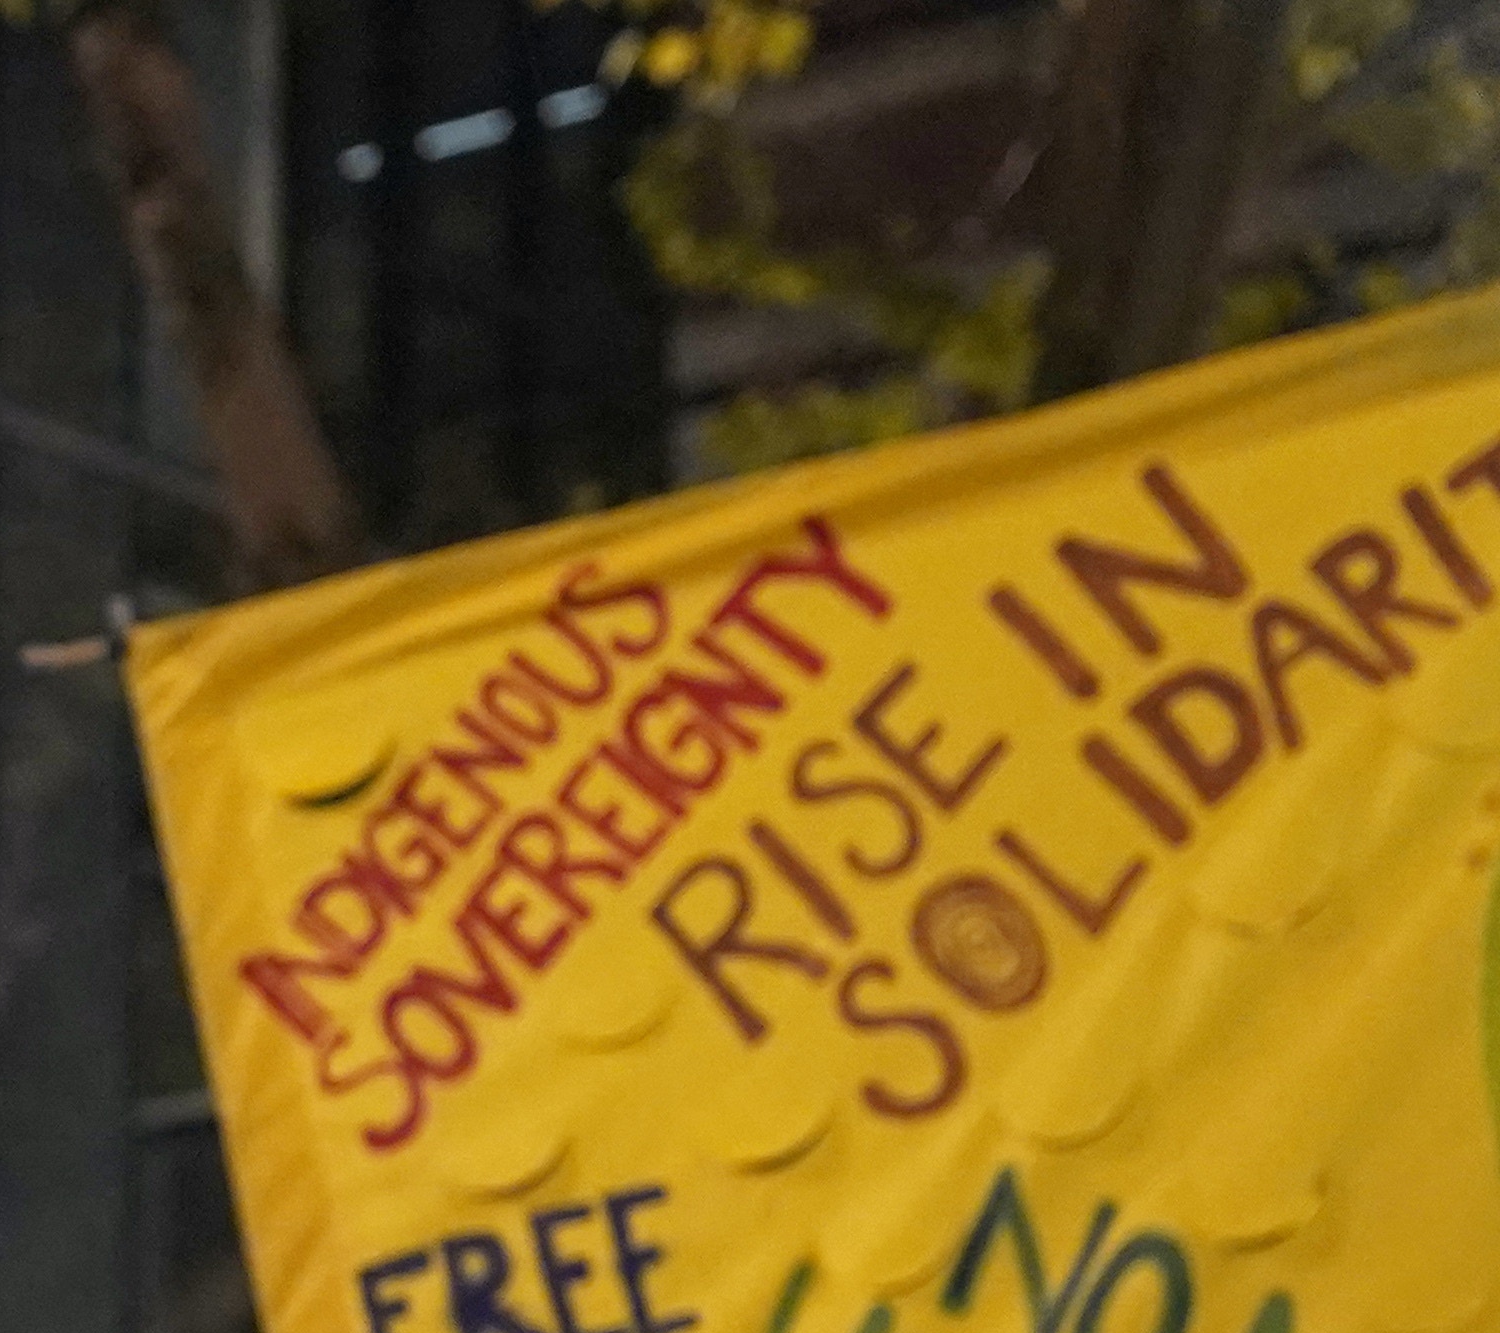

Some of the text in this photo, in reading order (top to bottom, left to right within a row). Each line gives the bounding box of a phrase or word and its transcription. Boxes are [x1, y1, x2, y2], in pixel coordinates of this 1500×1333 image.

[236, 560, 670, 1046] INDIGENOUS
[317, 514, 893, 1151] SOVEREIGNTY
[652, 461, 1252, 1045] RISE IN
